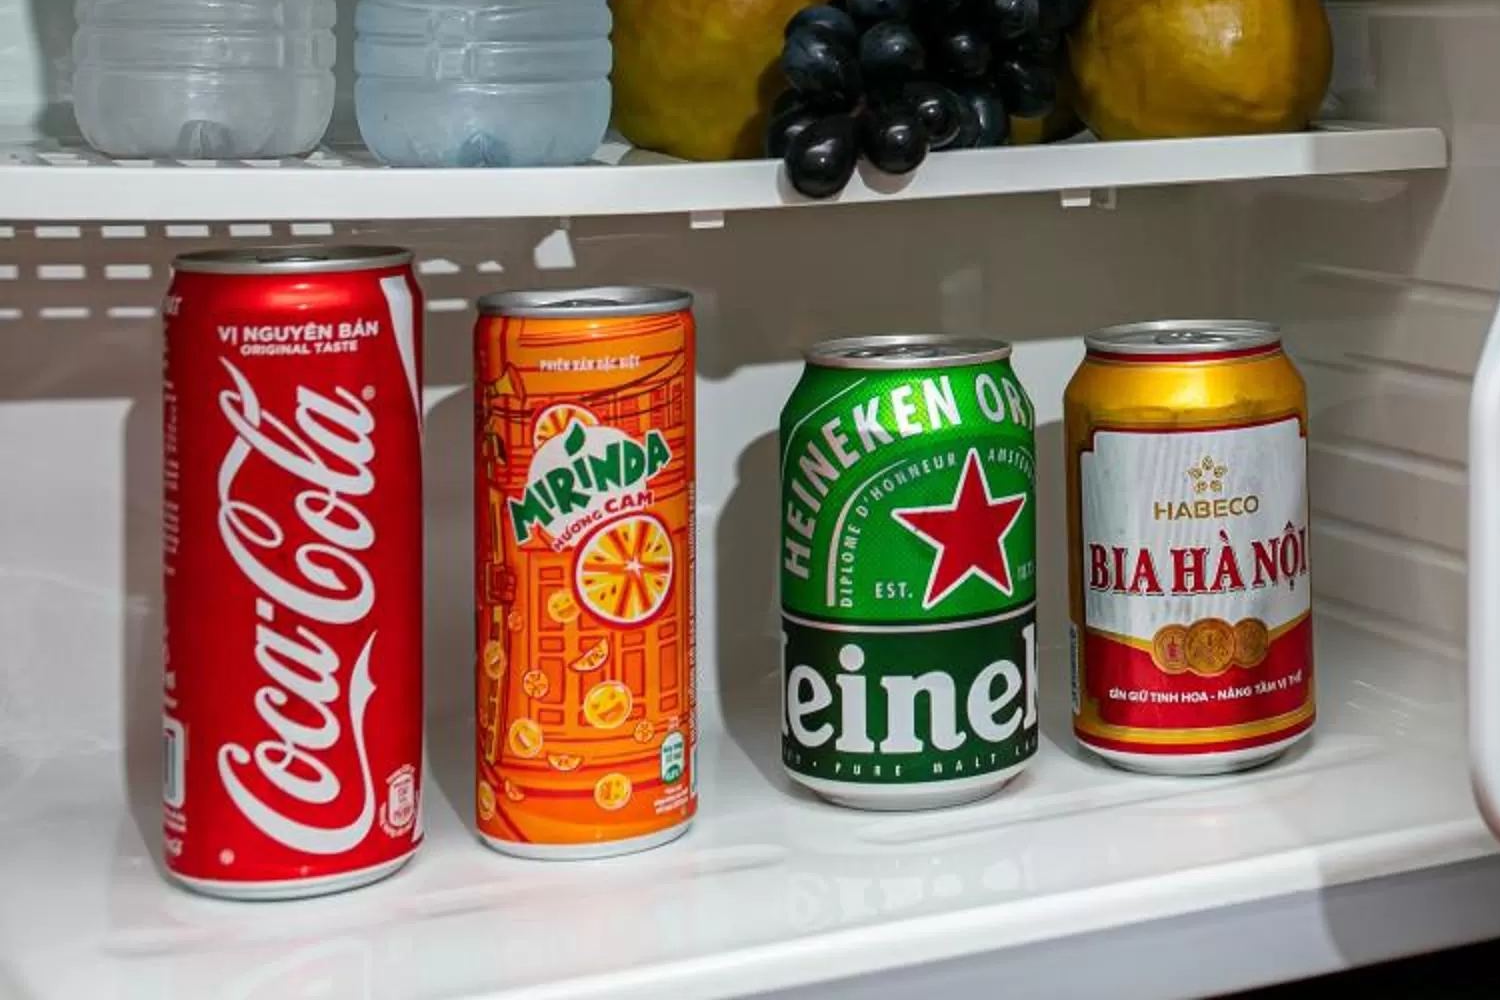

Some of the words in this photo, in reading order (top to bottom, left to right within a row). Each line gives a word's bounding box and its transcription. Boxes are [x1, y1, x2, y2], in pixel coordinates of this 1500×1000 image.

[243, 322, 334, 342] NGUYÊN
[240, 342, 310, 356] ORIGINAL
[314, 339, 358, 354] TASTE
[784, 375, 961, 580] HEINEKEN
[604, 490, 654, 514] CAM
[1154, 495, 1260, 520] HABECO
[840, 524, 861, 607] DIPLOME
[1089, 542, 1164, 596] BIA
[1170, 528, 1246, 596] HÀ
[875, 582, 913, 600] EST.
[217, 355, 377, 855] Coca-Cola
[1150, 691, 1179, 704] TINH
[1181, 690, 1209, 703] HOA
[835, 762, 902, 776] PURE
[933, 752, 996, 774] MALT
